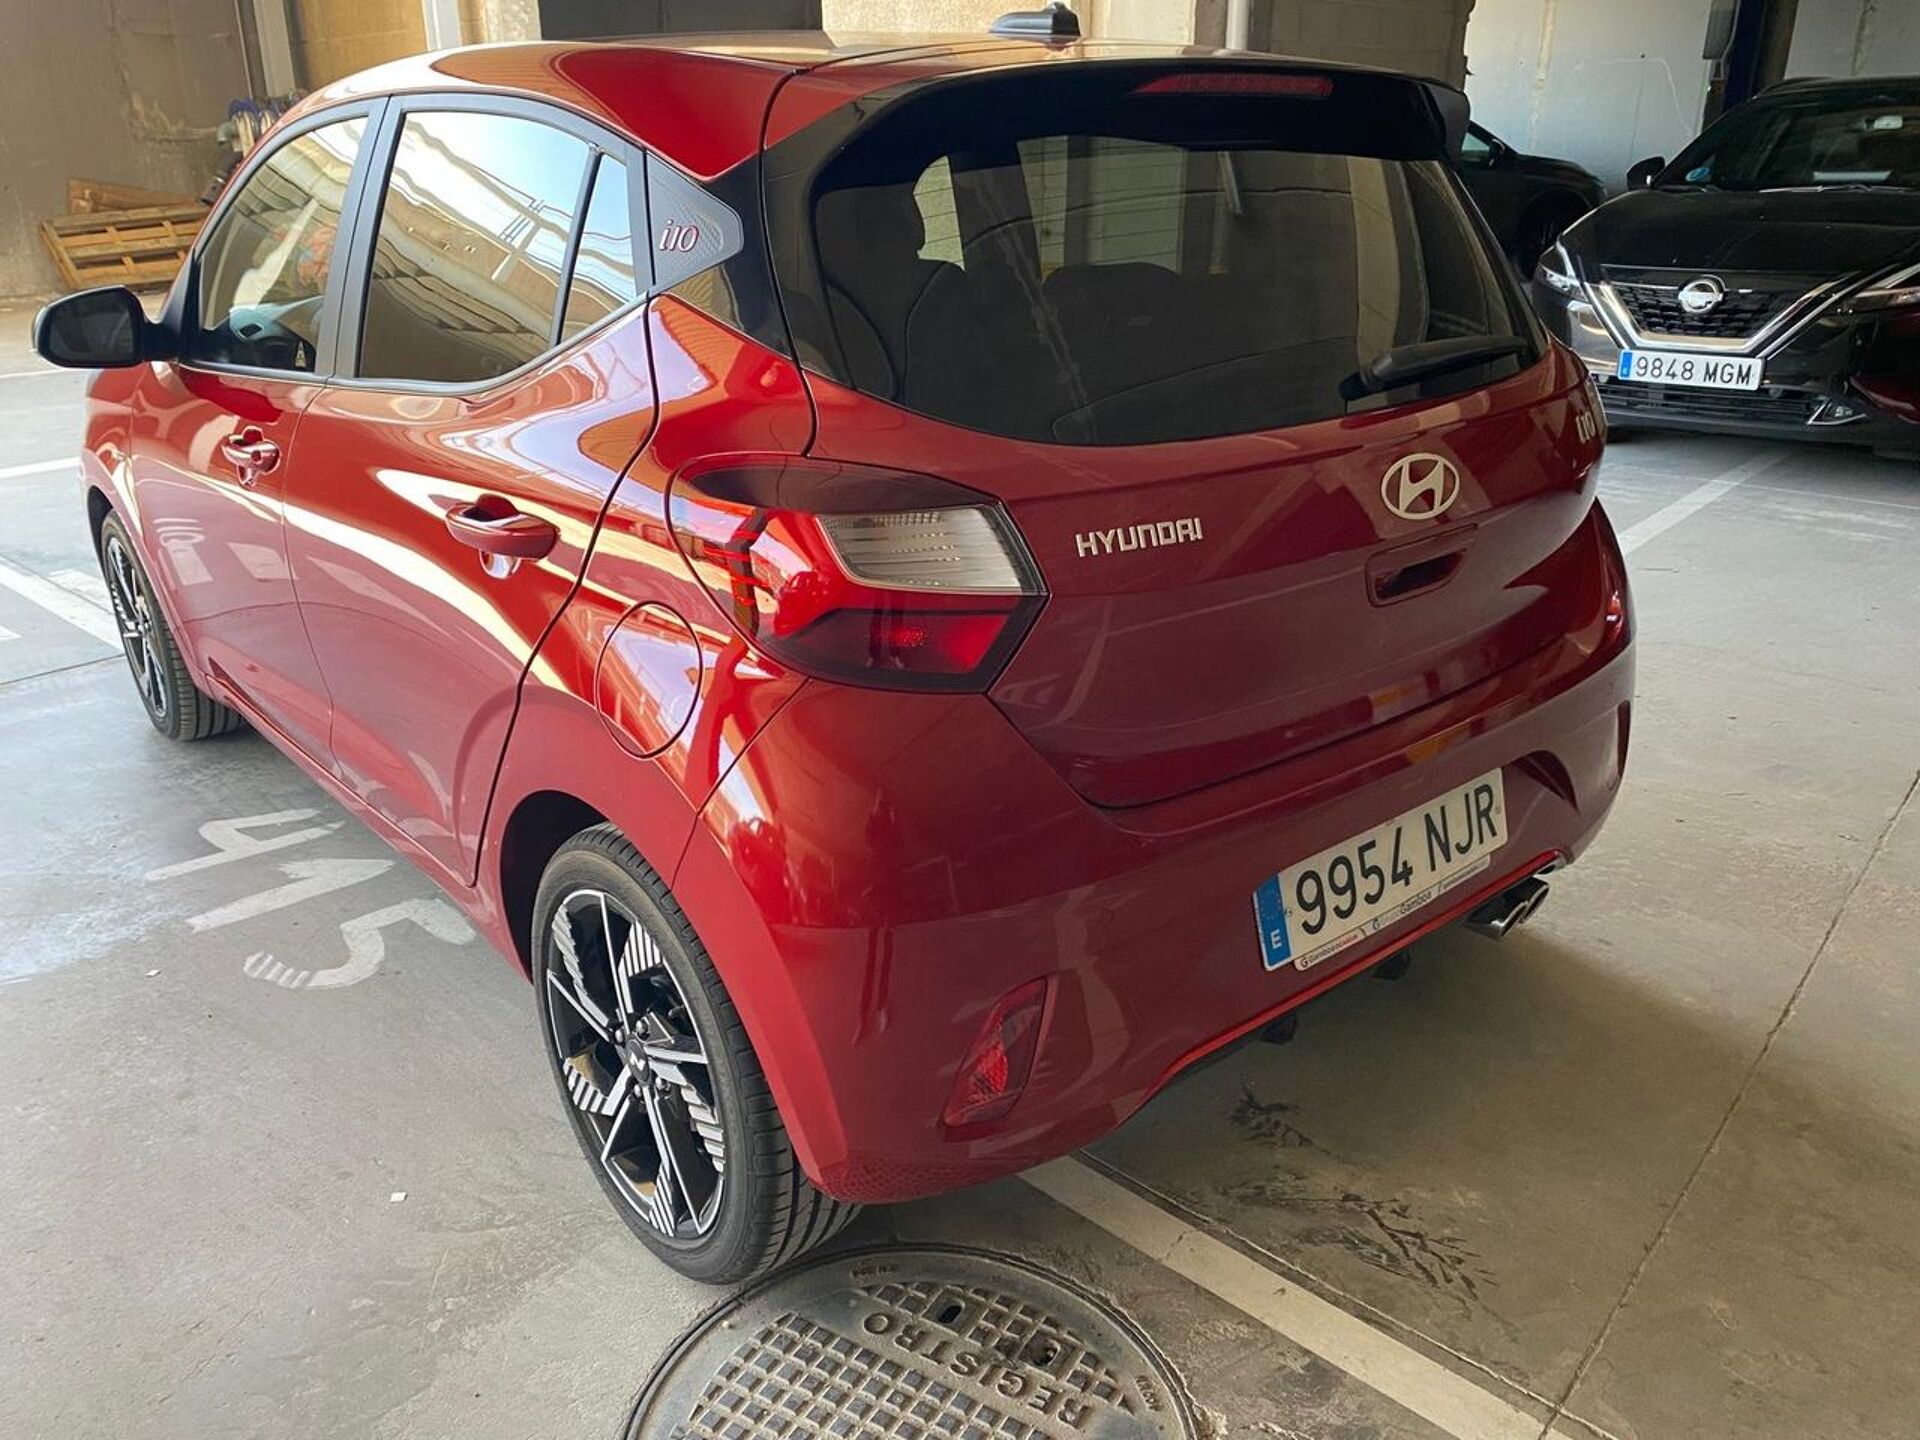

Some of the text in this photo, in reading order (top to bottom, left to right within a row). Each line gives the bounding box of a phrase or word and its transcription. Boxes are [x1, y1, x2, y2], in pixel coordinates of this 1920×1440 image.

[659, 219, 700, 252] i10
[1635, 356, 1694, 381] 9848
[1703, 361, 1752, 385] MGM
[1075, 517, 1203, 557] HYUNDAI
[1296, 783, 1497, 935] 9954 NJR
[1270, 929, 1283, 949] E
[863, 1312, 1090, 1429] REGISTRO
